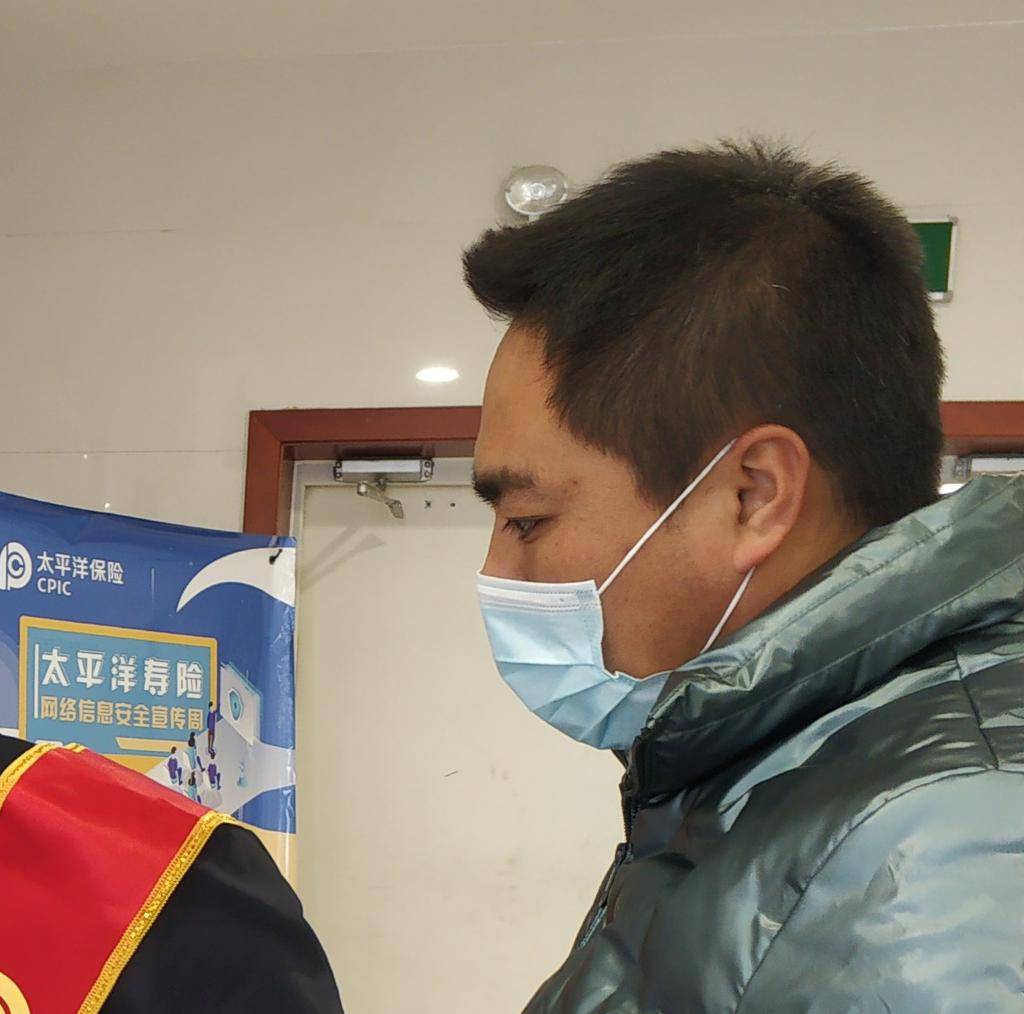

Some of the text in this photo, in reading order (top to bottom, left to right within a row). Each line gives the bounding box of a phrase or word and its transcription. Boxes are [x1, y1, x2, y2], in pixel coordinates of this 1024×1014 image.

[36, 551, 125, 586] 太平洋保险
[37, 576, 72, 597] CPIC
[41, 647, 205, 700] 太平洋寿险
[40, 695, 205, 732] 网络信息安全宣传周
